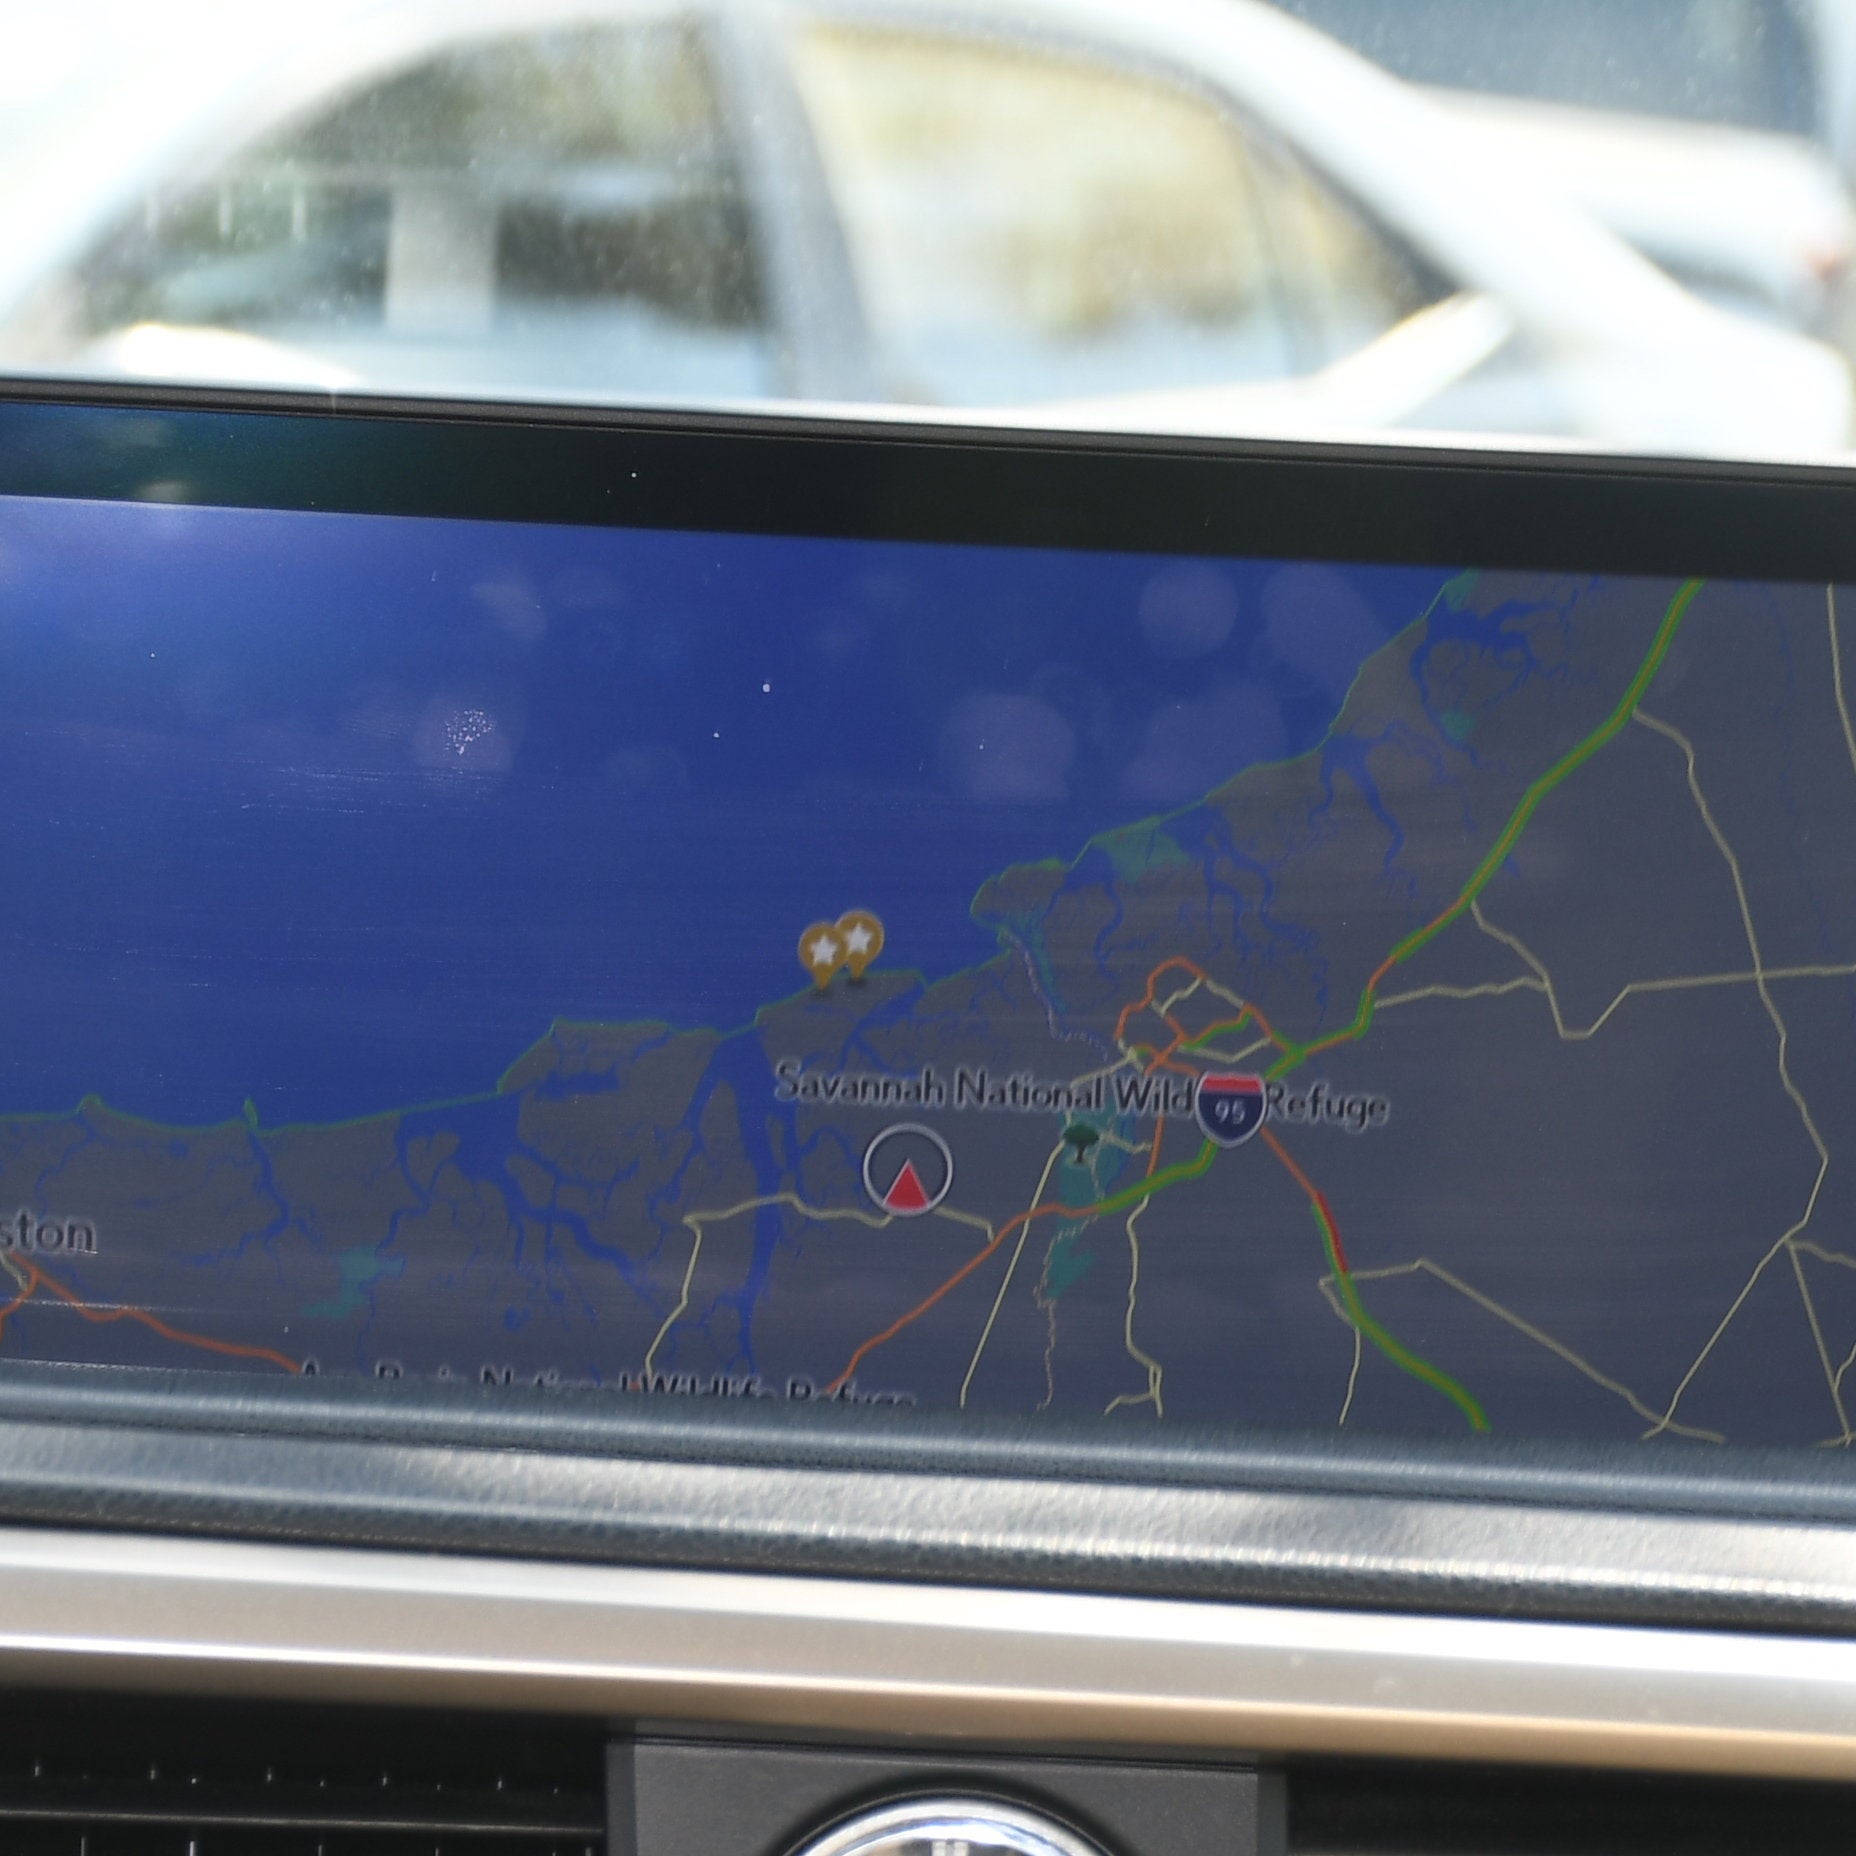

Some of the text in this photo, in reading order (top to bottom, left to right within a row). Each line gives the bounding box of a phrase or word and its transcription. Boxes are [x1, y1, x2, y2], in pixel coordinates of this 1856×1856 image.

[776, 1062, 943, 1102] Savannah
[954, 1069, 1105, 1110] National
[1266, 1079, 1388, 1133] Refuge
[1215, 1102, 1245, 1122] 95
